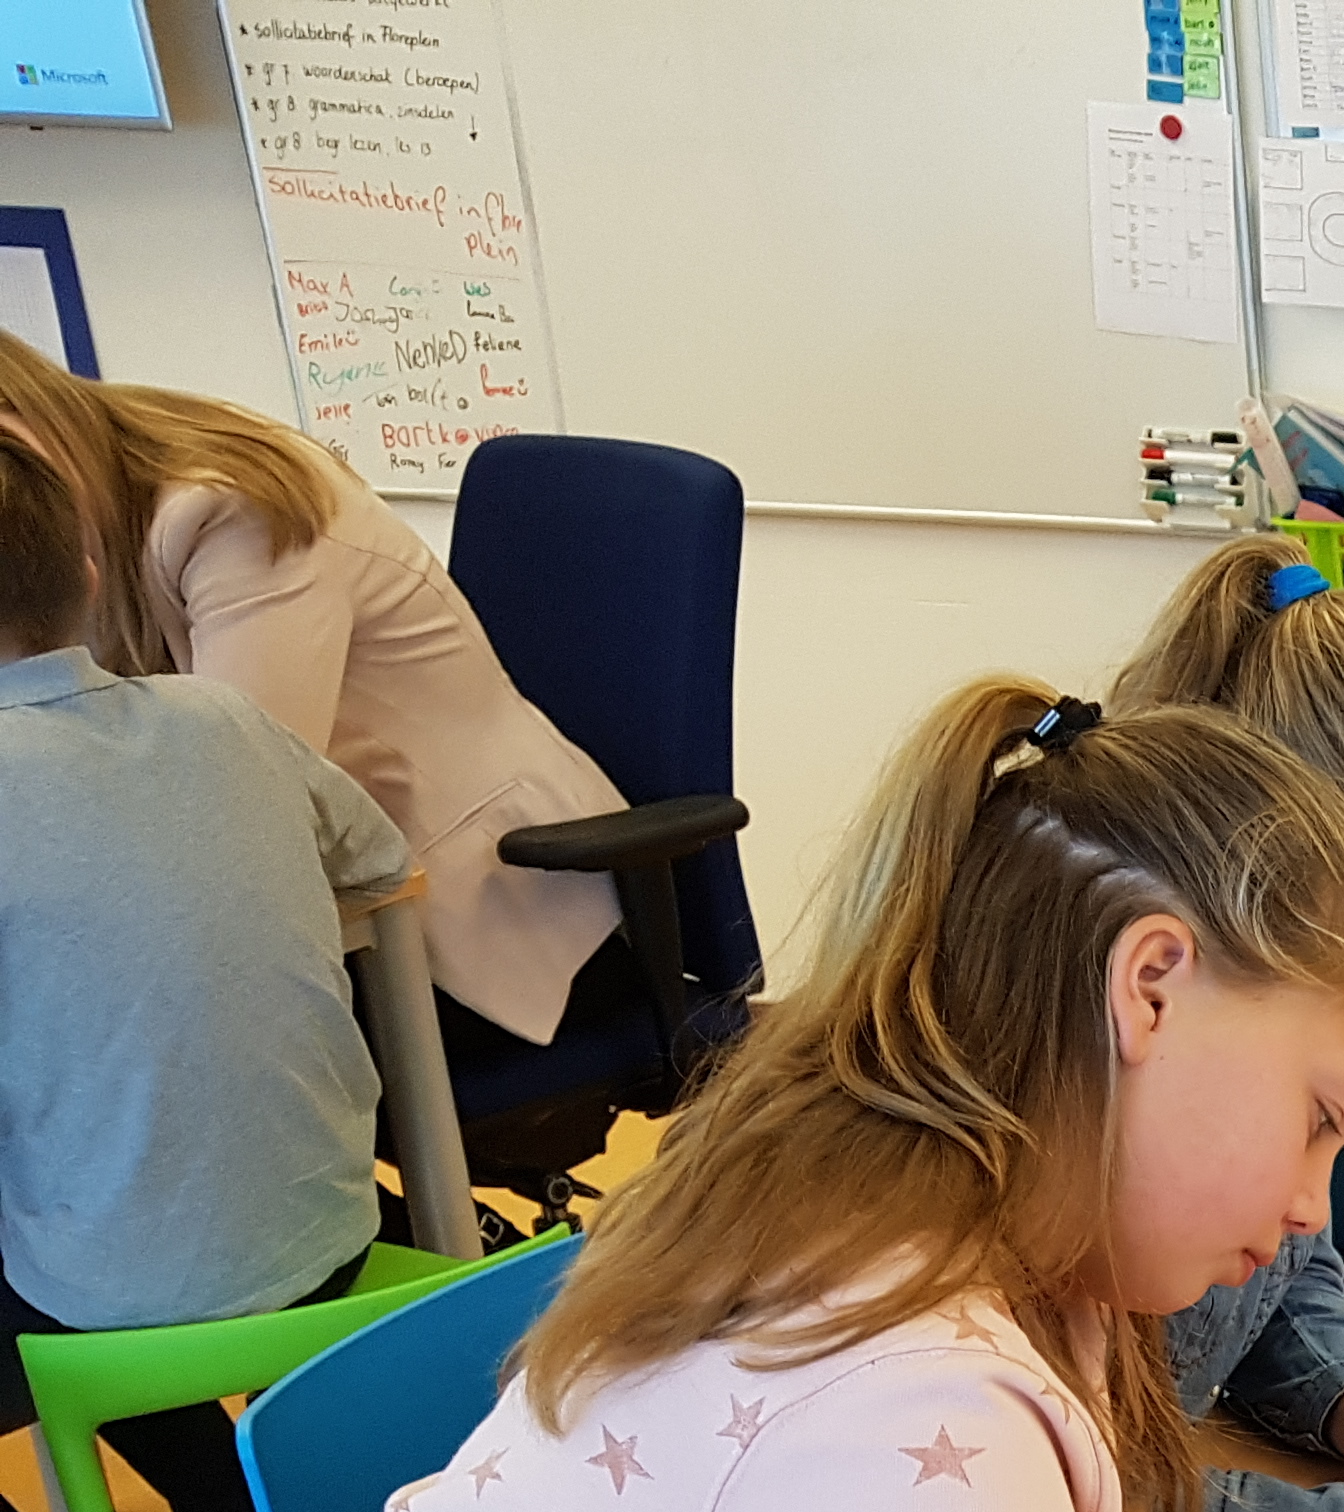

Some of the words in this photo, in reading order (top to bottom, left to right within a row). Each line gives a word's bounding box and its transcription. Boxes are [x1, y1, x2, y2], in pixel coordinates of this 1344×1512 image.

[362, 31, 376, 44] in
[41, 69, 108, 85] Microsoft
[339, 272, 353, 298] A
